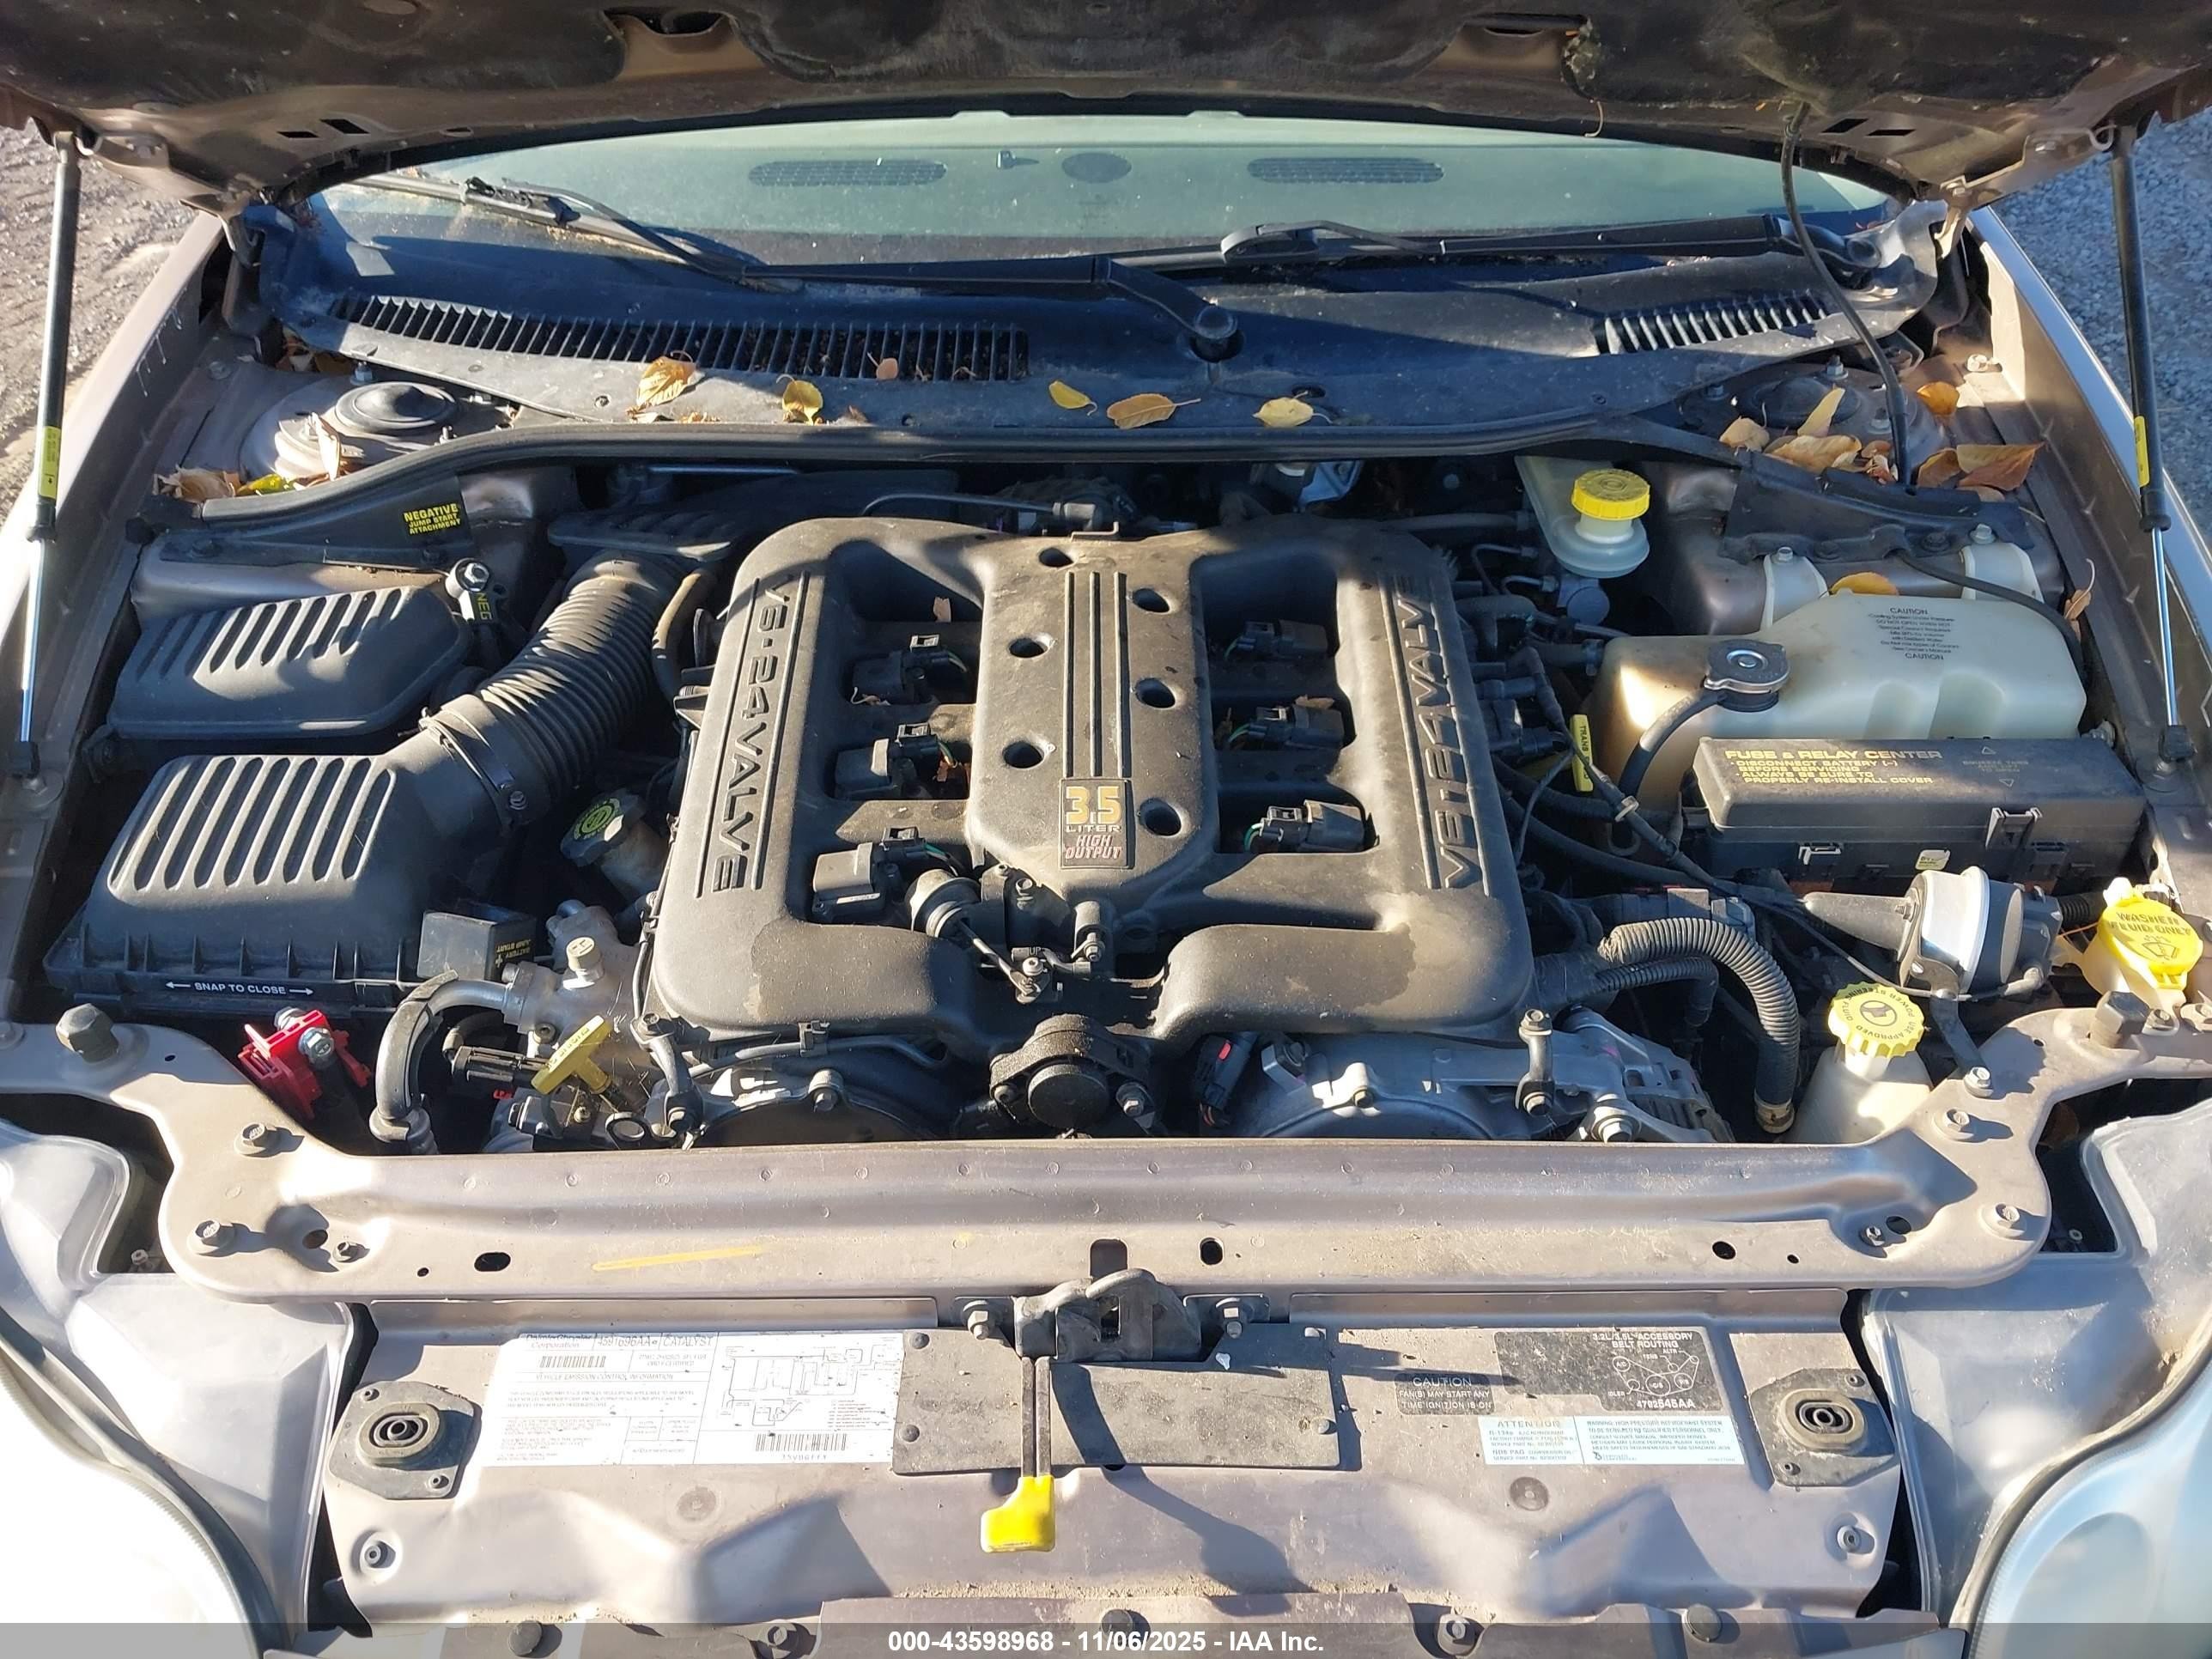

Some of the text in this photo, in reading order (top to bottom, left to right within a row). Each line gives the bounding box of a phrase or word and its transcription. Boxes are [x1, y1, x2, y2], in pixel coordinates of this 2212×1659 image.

[404, 503, 459, 522] NEGATIVE
[409, 513, 457, 528] JUMP START
[410, 518, 460, 534] ATTACHMENT
[476, 592, 492, 620] NEG
[1580, 726, 1589, 752] TRANS
[1725, 750, 1778, 759] FUSE
[1797, 750, 1858, 759] RELAY
[1864, 750, 1943, 759] CENTER
[1066, 786, 1122, 824] 3.5
[1066, 824, 1121, 833] LITER
[1076, 834, 1114, 847] HIGH
[1065, 846, 1122, 860] OUTPUT
[2116, 912, 2180, 926] WASHER
[2109, 921, 2191, 936] FLUID ONLY
[1030, 946, 1042, 956] UP
[194, 981, 287, 995] SNAP TO CLOSE
[1841, 1000, 1853, 1021] FLUID
[1889, 994, 1916, 1018] POWER
[1856, 1024, 1905, 1040] APPROVED
[663, 1334, 712, 1347] CATALYST
[1638, 1332, 1693, 1340] ACCESSORY
[1413, 1377, 1472, 1387] CAUTION
[1399, 1390, 1490, 1400] FAN(S) MAY START ANY
